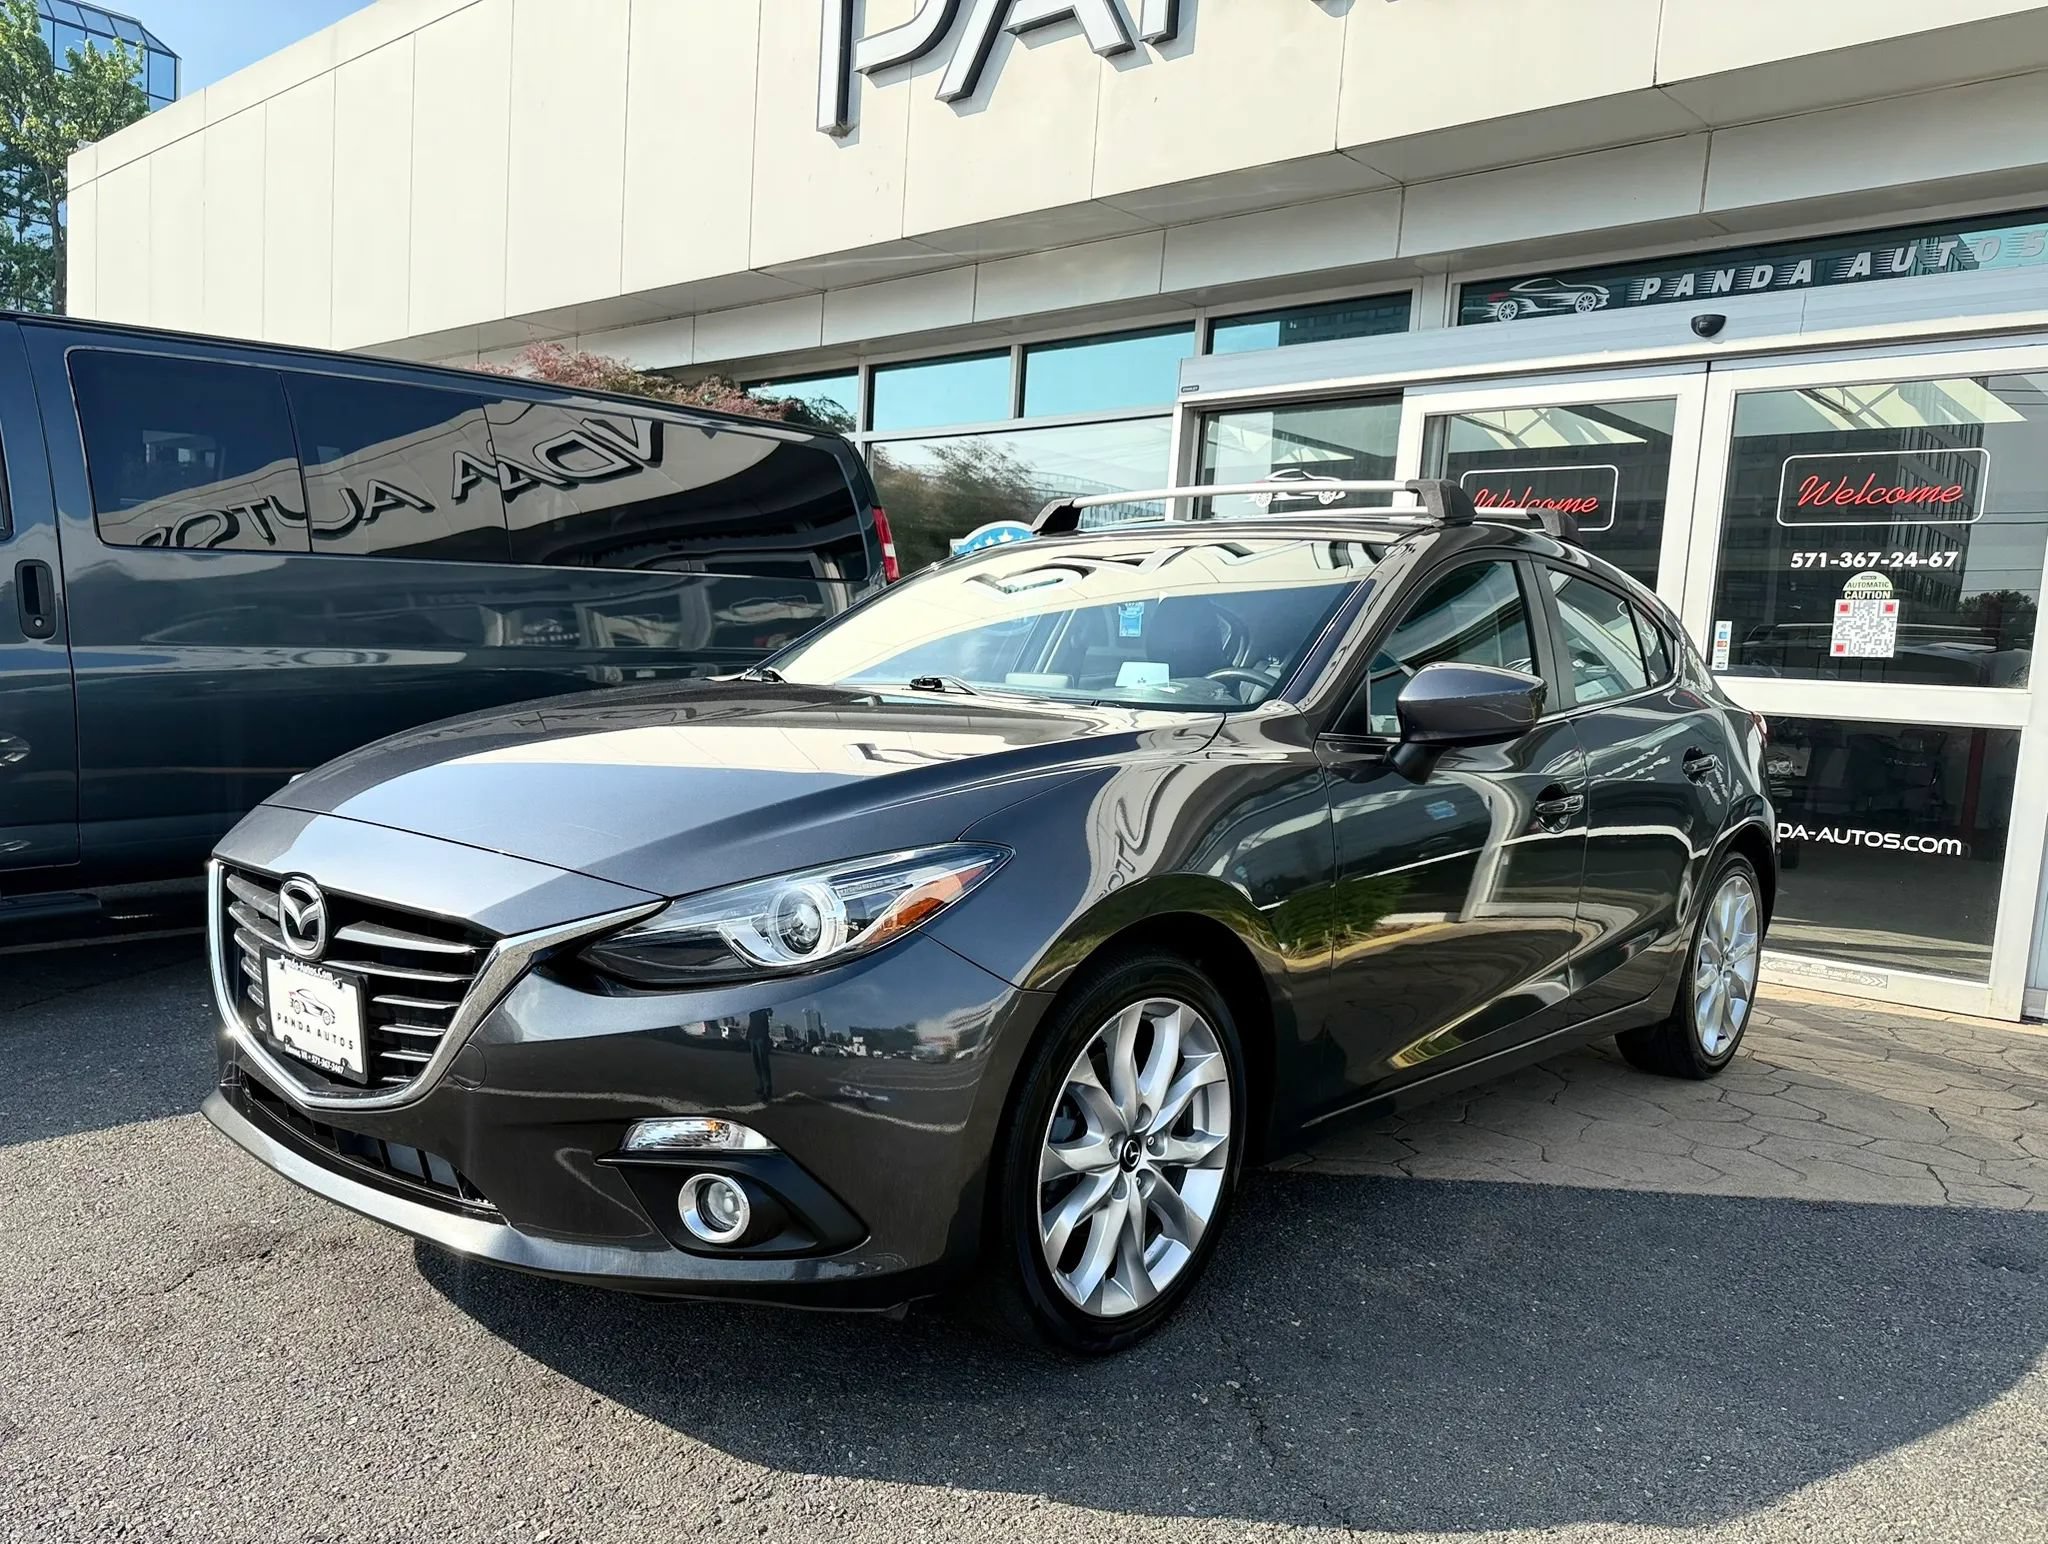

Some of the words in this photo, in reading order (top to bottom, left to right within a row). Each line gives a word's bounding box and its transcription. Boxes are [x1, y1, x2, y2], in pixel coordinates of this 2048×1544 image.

[1632, 259, 1812, 301] PANDA
[1837, 230, 2048, 278] AUTOS
[1797, 472, 1965, 507] Welcome
[1790, 551, 1959, 569] 571-367-24-67
[1844, 590, 1891, 600] CAUTION
[1847, 581, 1890, 589] AUTOMATIC
[276, 1012, 311, 1034] PANDA
[316, 1028, 354, 1050] AUTOS
